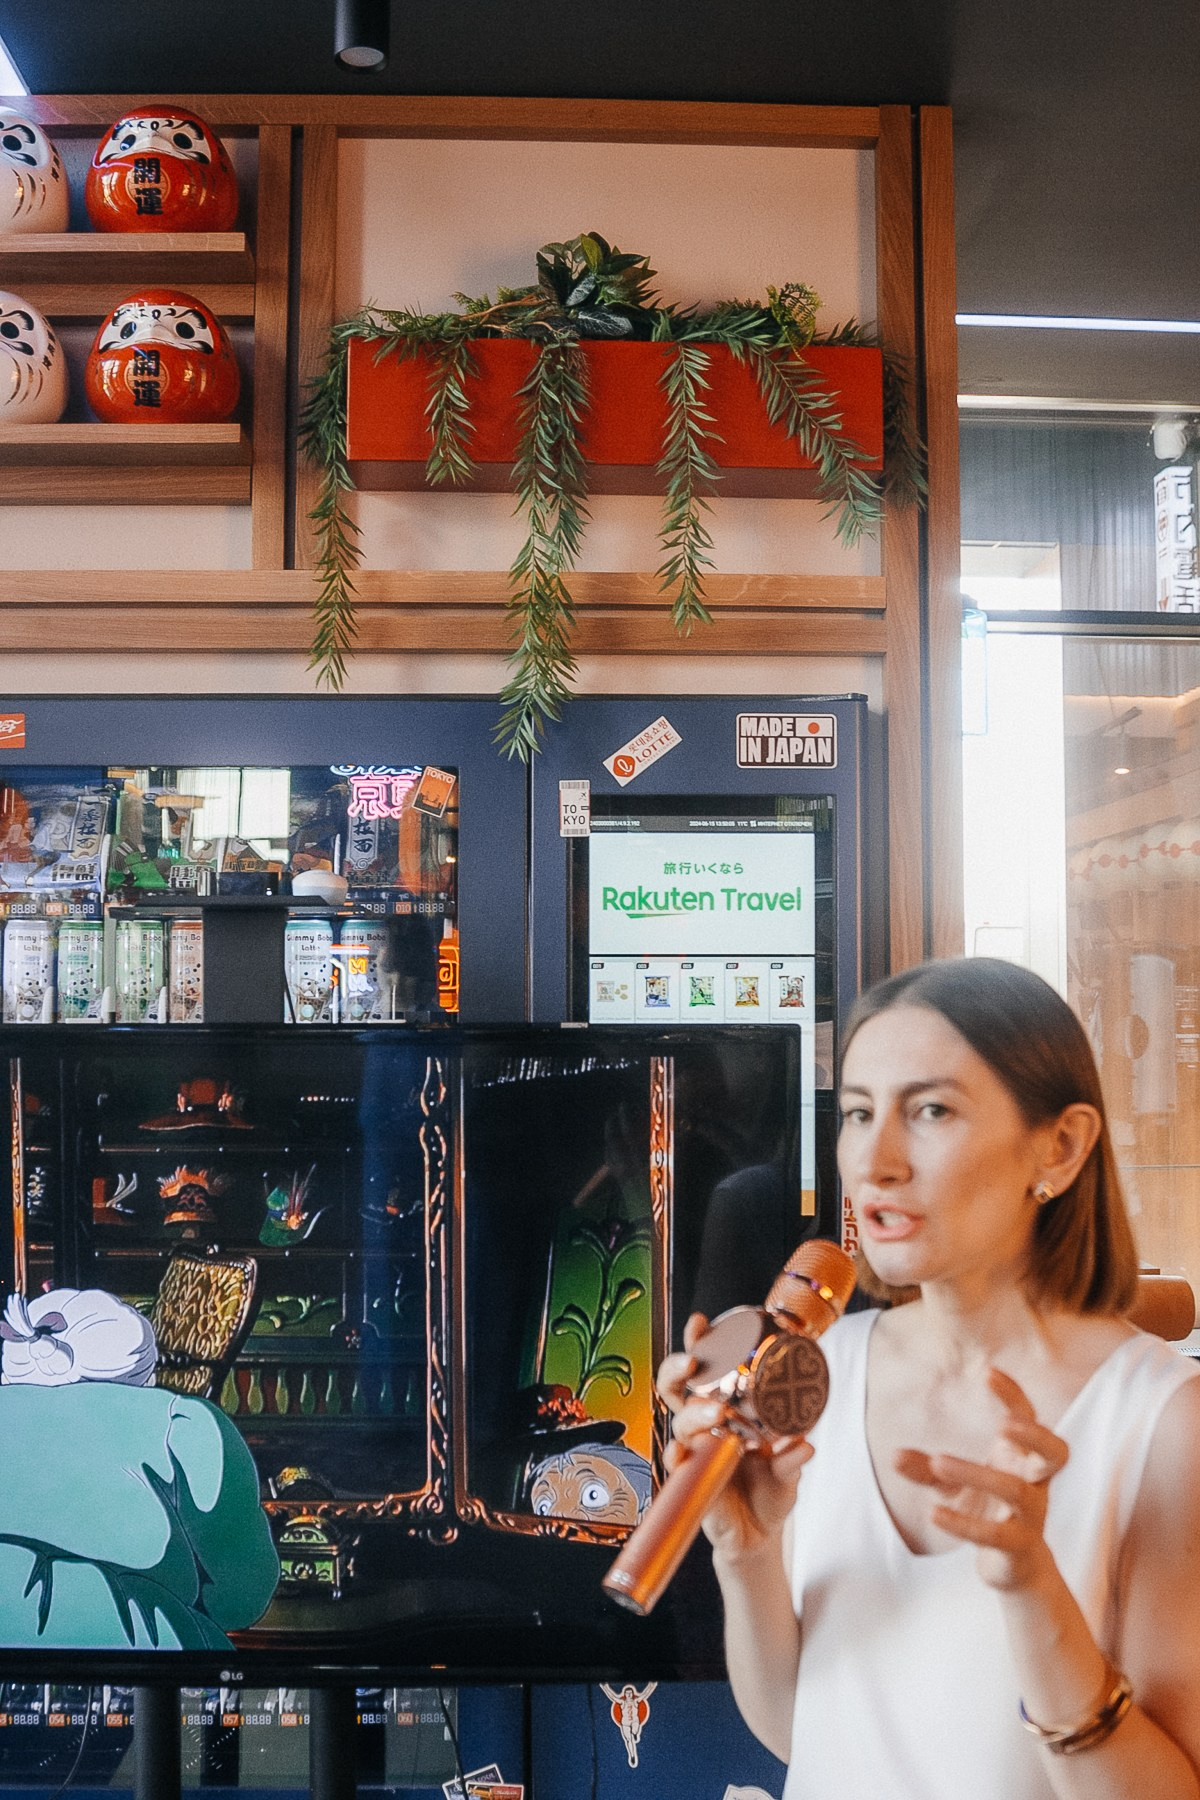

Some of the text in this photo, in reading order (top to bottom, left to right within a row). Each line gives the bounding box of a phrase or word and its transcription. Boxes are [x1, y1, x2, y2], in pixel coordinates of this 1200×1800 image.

[134, 350, 161, 408] 開運
[741, 718, 794, 736] MADE
[636, 731, 673, 762] LOTTE
[741, 738, 831, 762] IN JAPAN
[426, 769, 453, 784] TOKYO
[563, 805, 577, 813] TO
[564, 816, 585, 825] KYO
[664, 862, 744, 874] 旅行いくなら
[603, 886, 801, 911] Rakuten Travel
